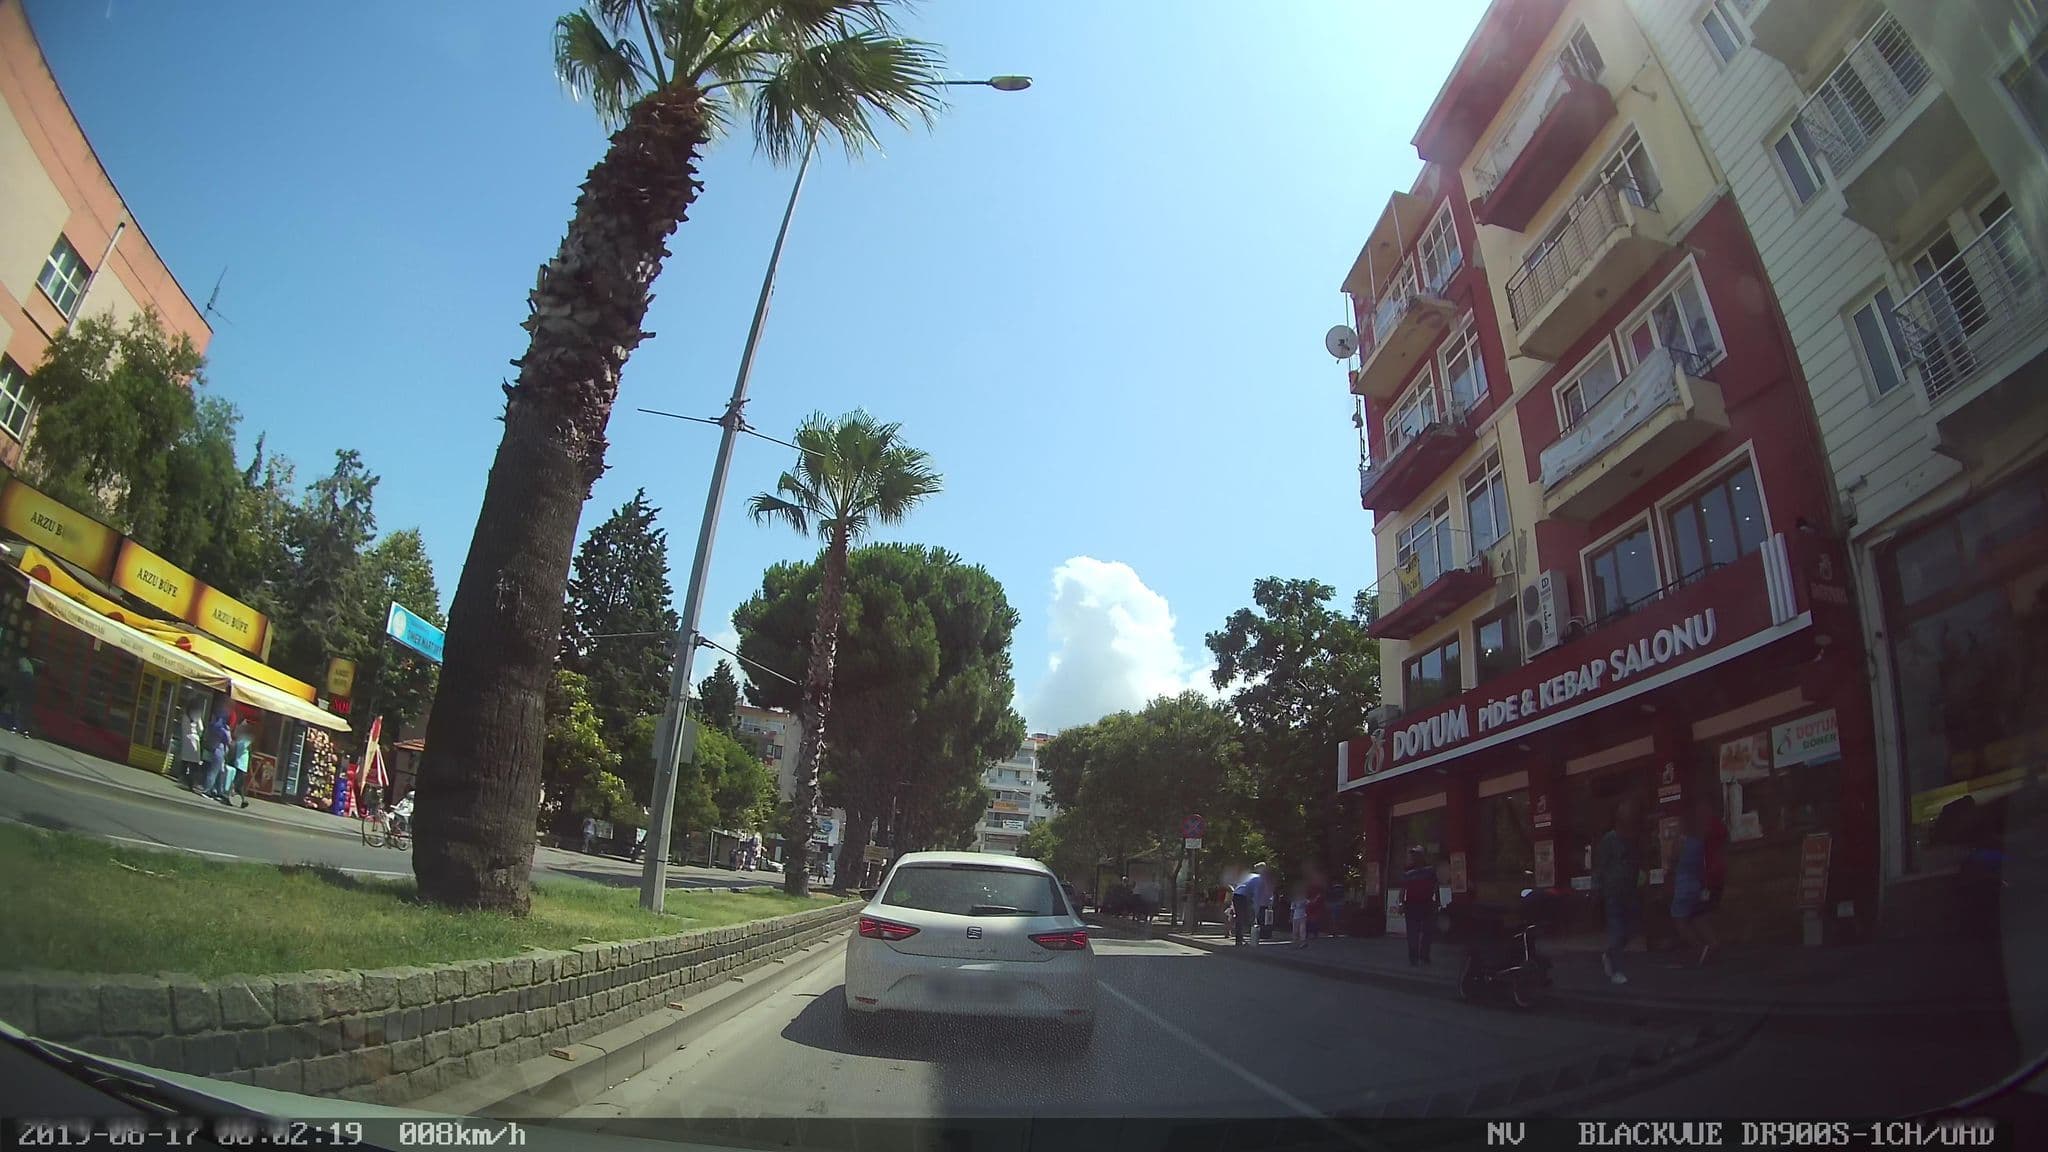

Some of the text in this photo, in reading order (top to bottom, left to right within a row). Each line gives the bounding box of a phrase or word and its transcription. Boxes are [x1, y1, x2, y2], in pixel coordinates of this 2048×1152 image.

[30, 512, 55, 532] ARZU
[137, 568, 159, 586] ARZU
[212, 608, 230, 625] ARZU
[1393, 704, 1471, 761] DOYUM
[1520, 689, 1538, 714] &
[1539, 658, 1607, 710] KEBAP
[1610, 607, 1717, 682] SALONU
